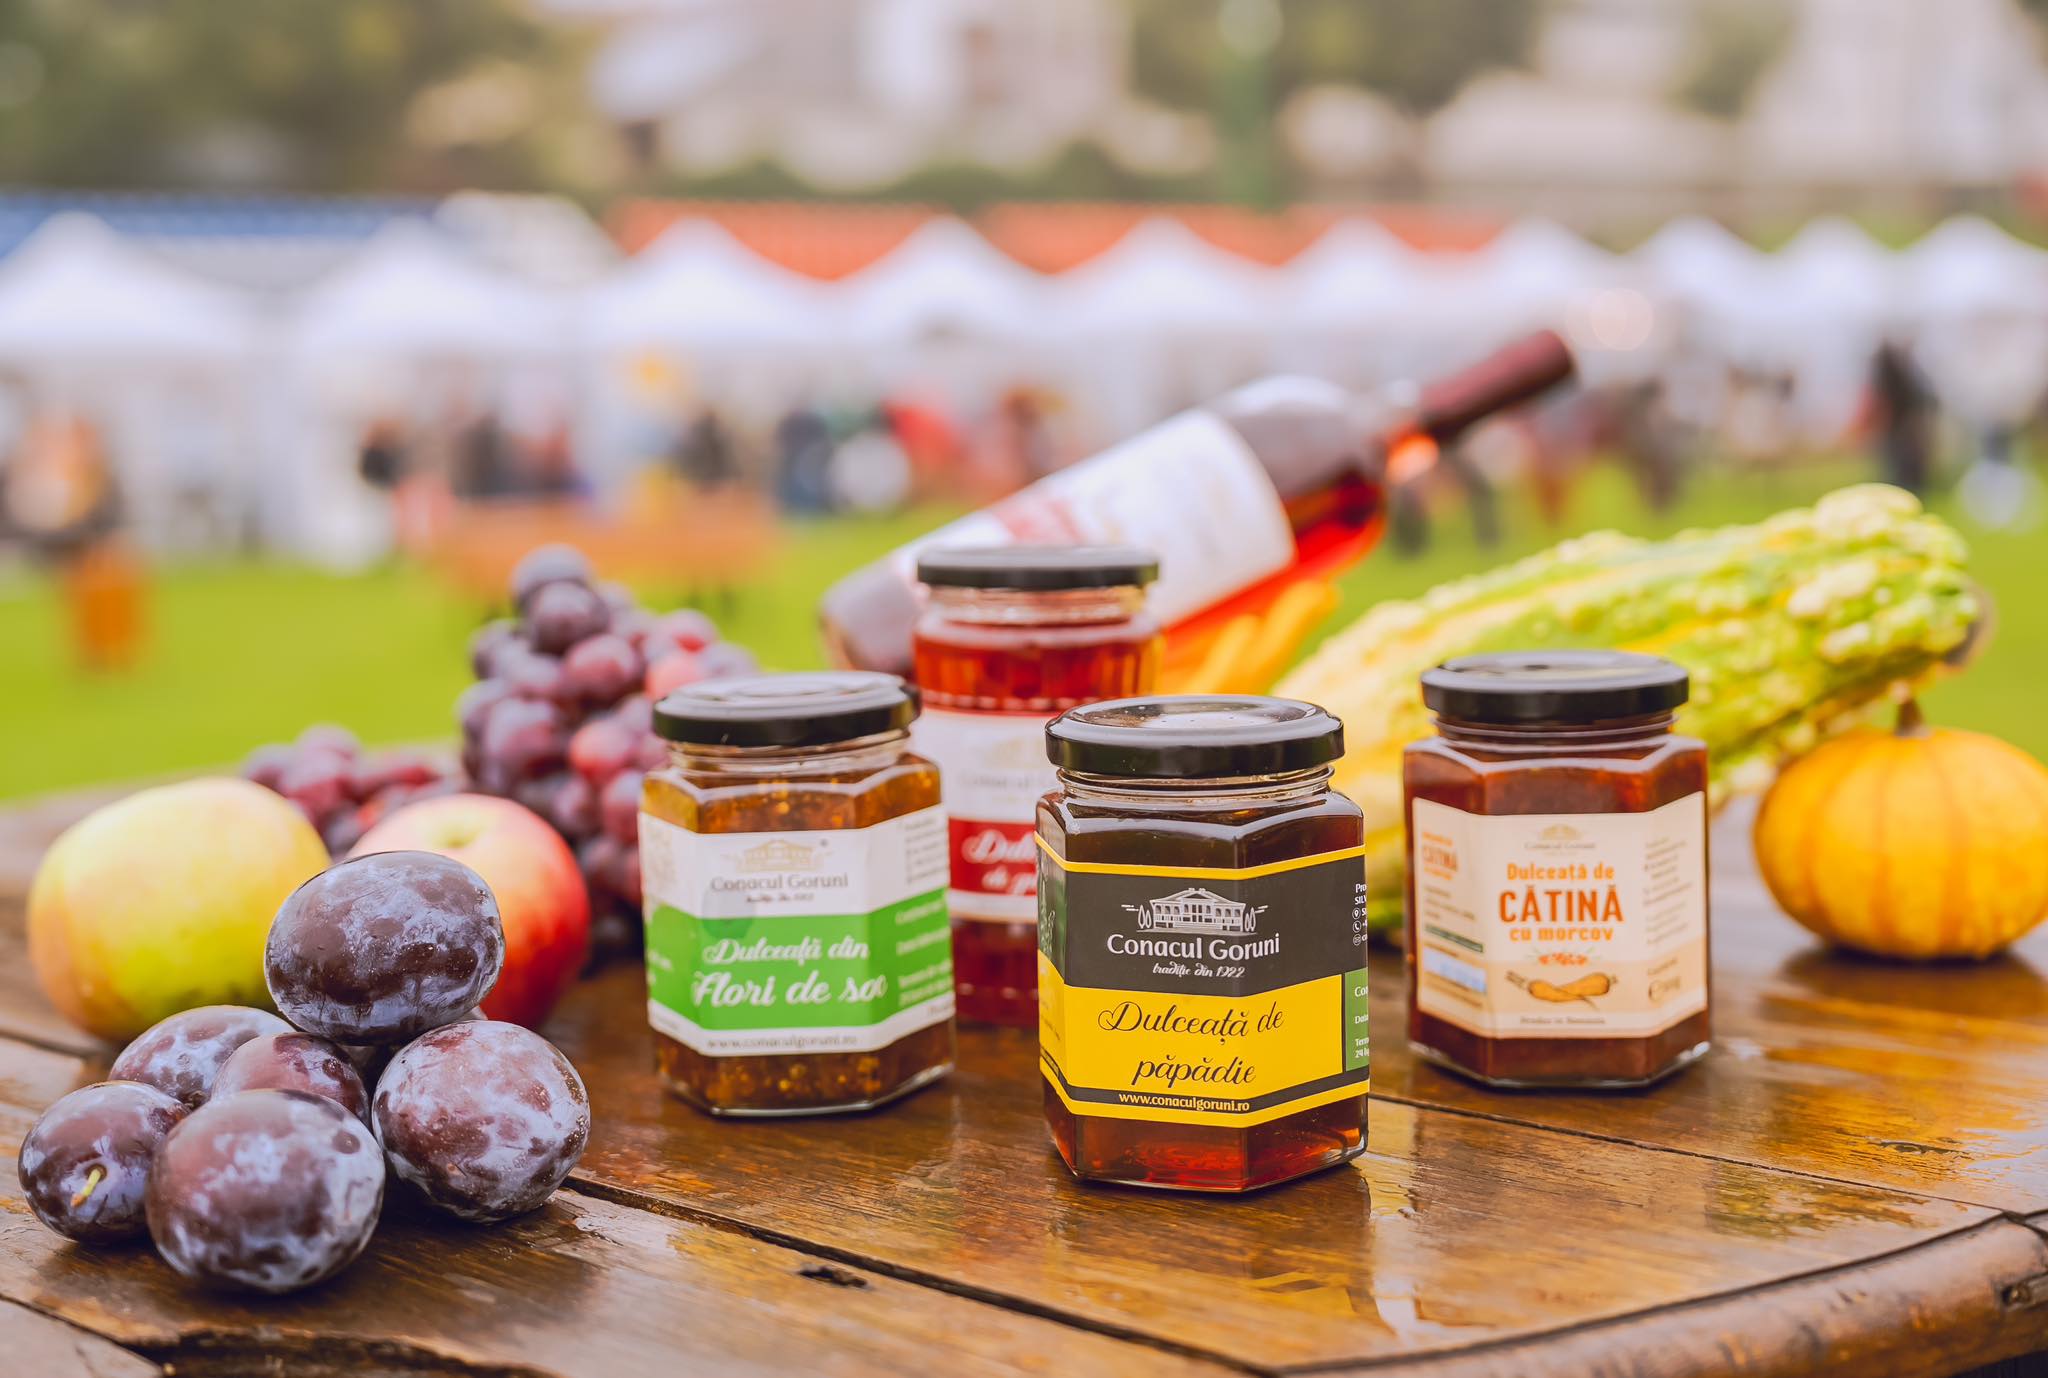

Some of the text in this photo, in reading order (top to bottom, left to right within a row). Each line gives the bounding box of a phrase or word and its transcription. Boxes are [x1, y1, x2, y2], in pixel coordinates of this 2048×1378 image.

[711, 873, 849, 891] Conacul Goruni
[1593, 861, 1615, 880] de
[1498, 884, 1624, 922] CĂTINĂ
[1509, 927, 1614, 941] cu morcov
[828, 935, 869, 960] din
[1107, 933, 1280, 961] Conacul Goruni
[1194, 963, 1213, 977] din
[1216, 966, 1246, 978] 1922
[691, 970, 776, 1007] Flori
[785, 970, 832, 1004] de
[1098, 1001, 1250, 1045] Dulceață
[1257, 1001, 1284, 1033] de
[1131, 1054, 1256, 1088] păpădie
[1118, 1093, 1250, 1112] www.conaculgoruni.ro
